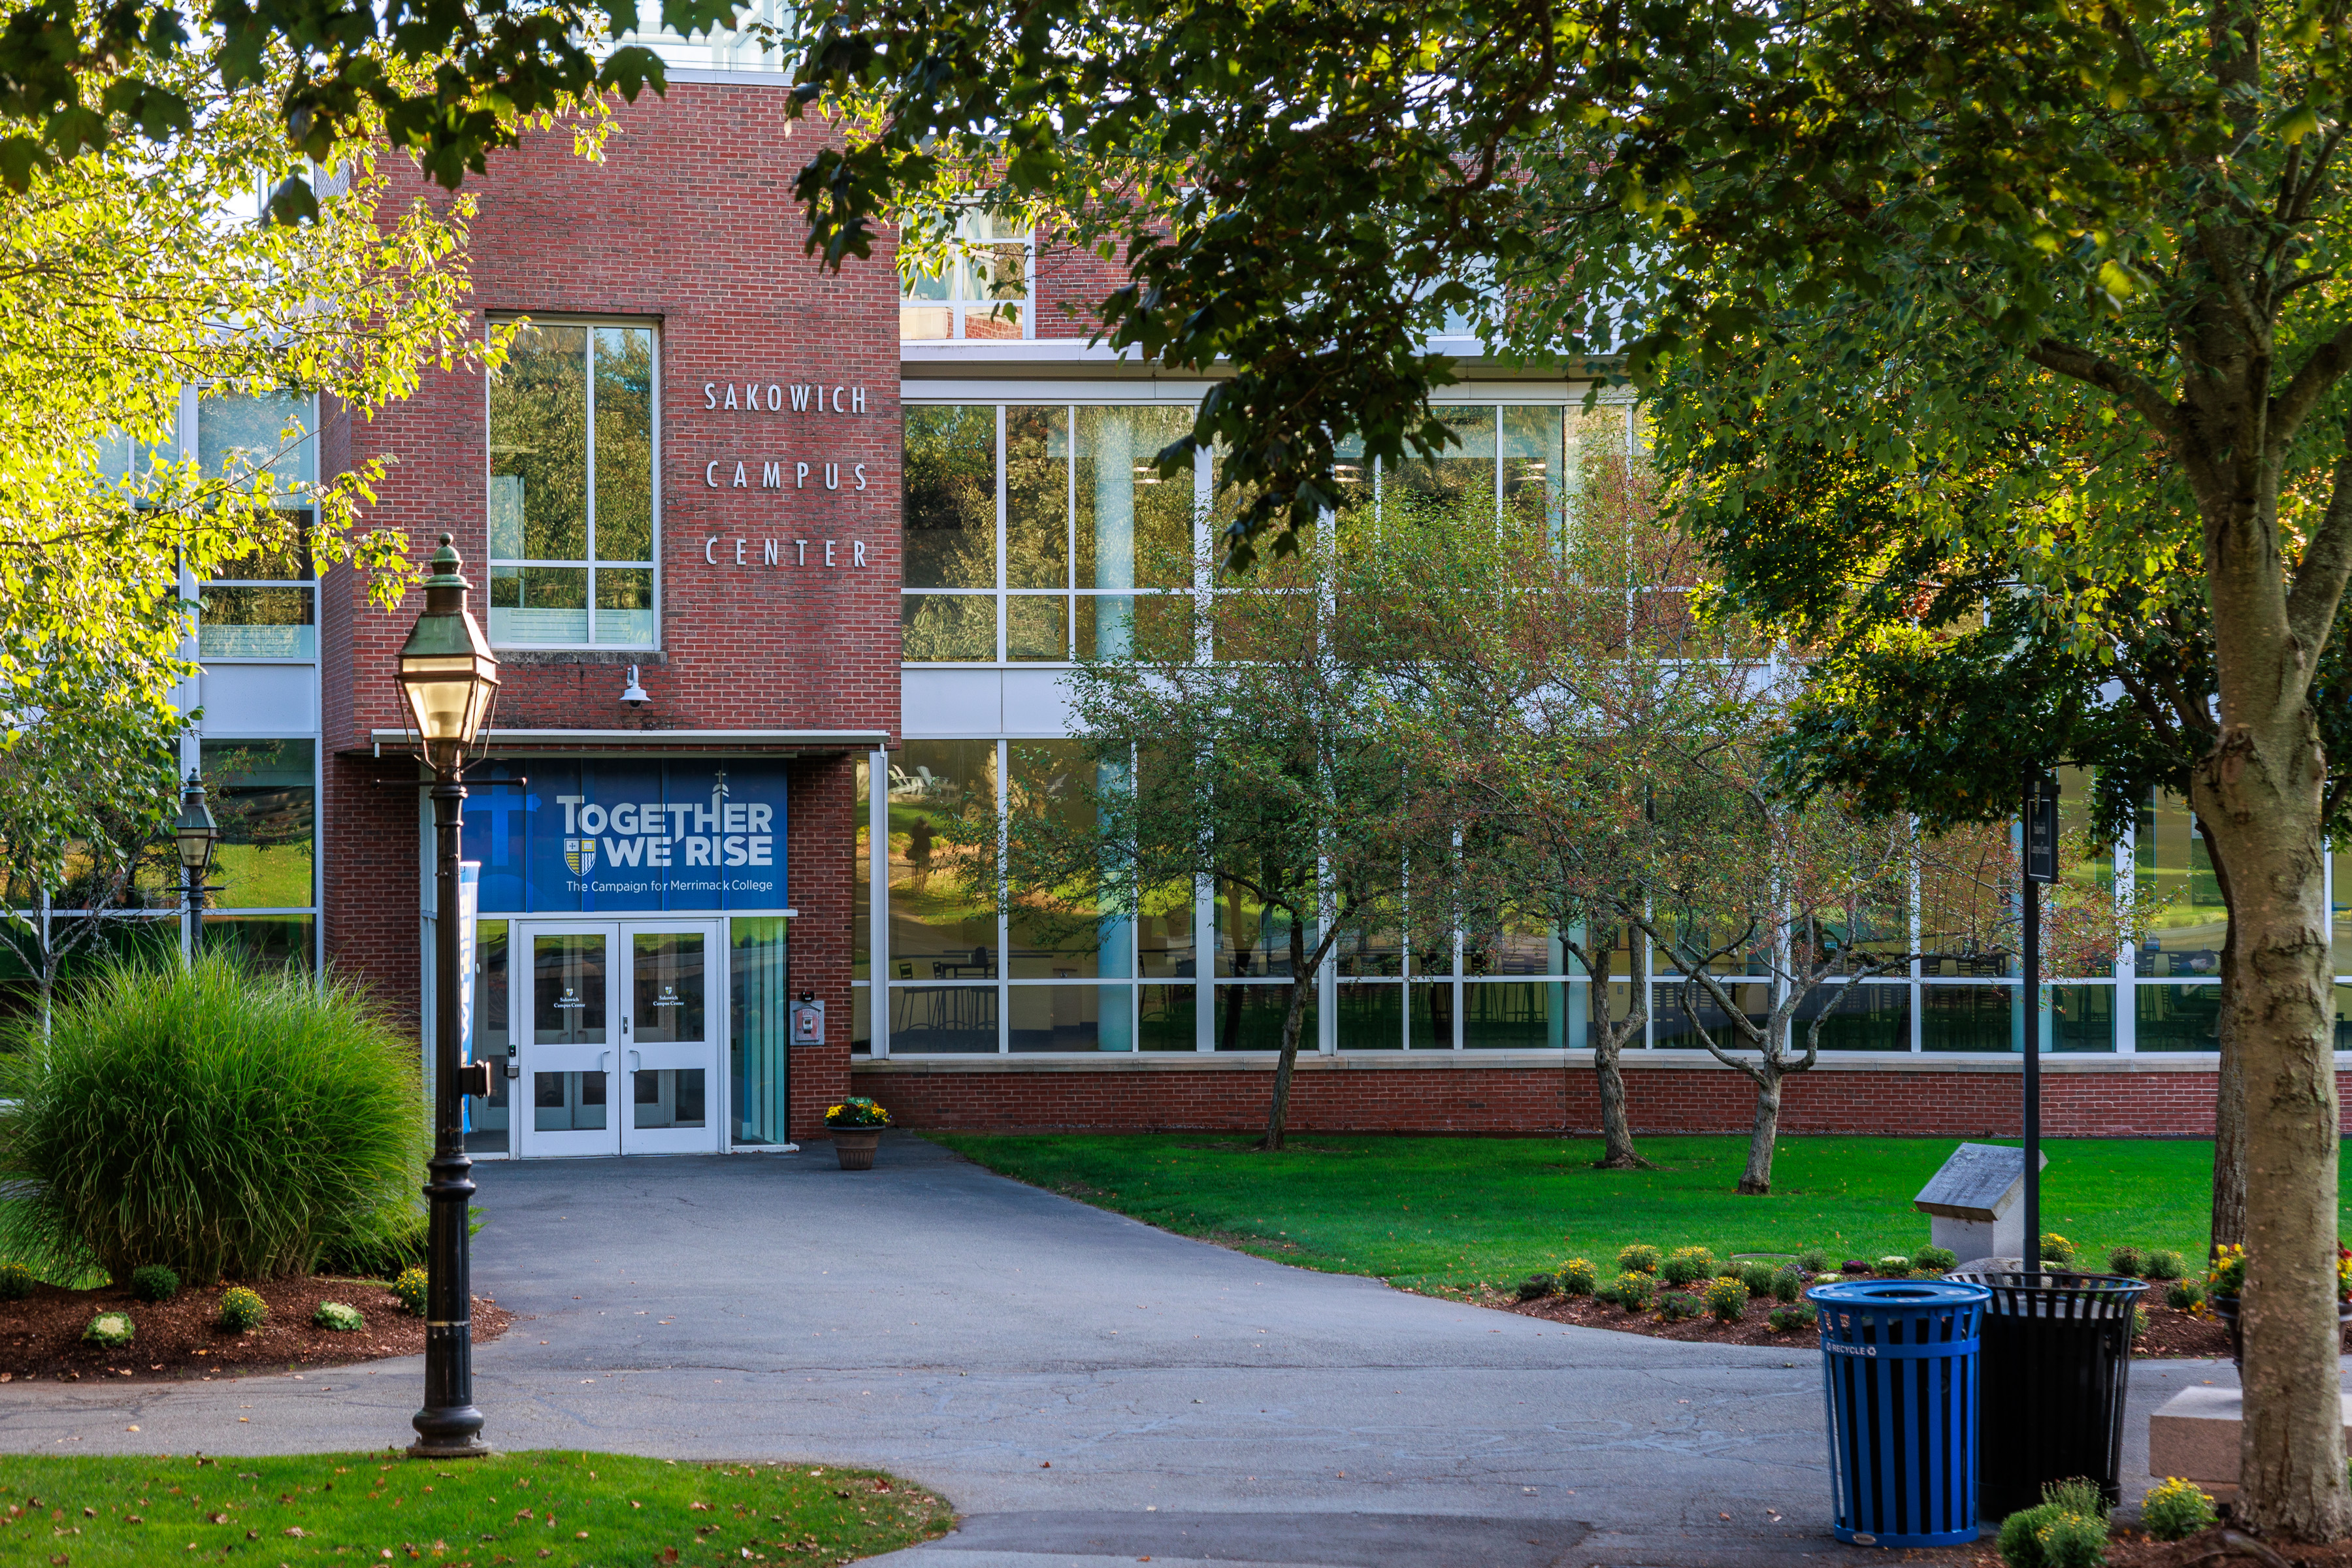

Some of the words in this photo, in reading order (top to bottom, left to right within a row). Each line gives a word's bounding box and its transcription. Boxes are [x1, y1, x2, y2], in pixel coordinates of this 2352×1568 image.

[704, 383, 866, 413] SAKOWICH
[706, 460, 866, 491] CAMPUS
[706, 536, 866, 567] CENTER
[557, 785, 773, 843] TOGETHER
[602, 836, 672, 867] WE
[686, 836, 773, 866] RISE
[566, 881, 588, 892] The
[591, 881, 647, 893] Campaign
[651, 880, 668, 891] for
[670, 879, 729, 891] Merrimack
[732, 879, 773, 892] College
[1832, 1343, 1866, 1356] RECYCLE
